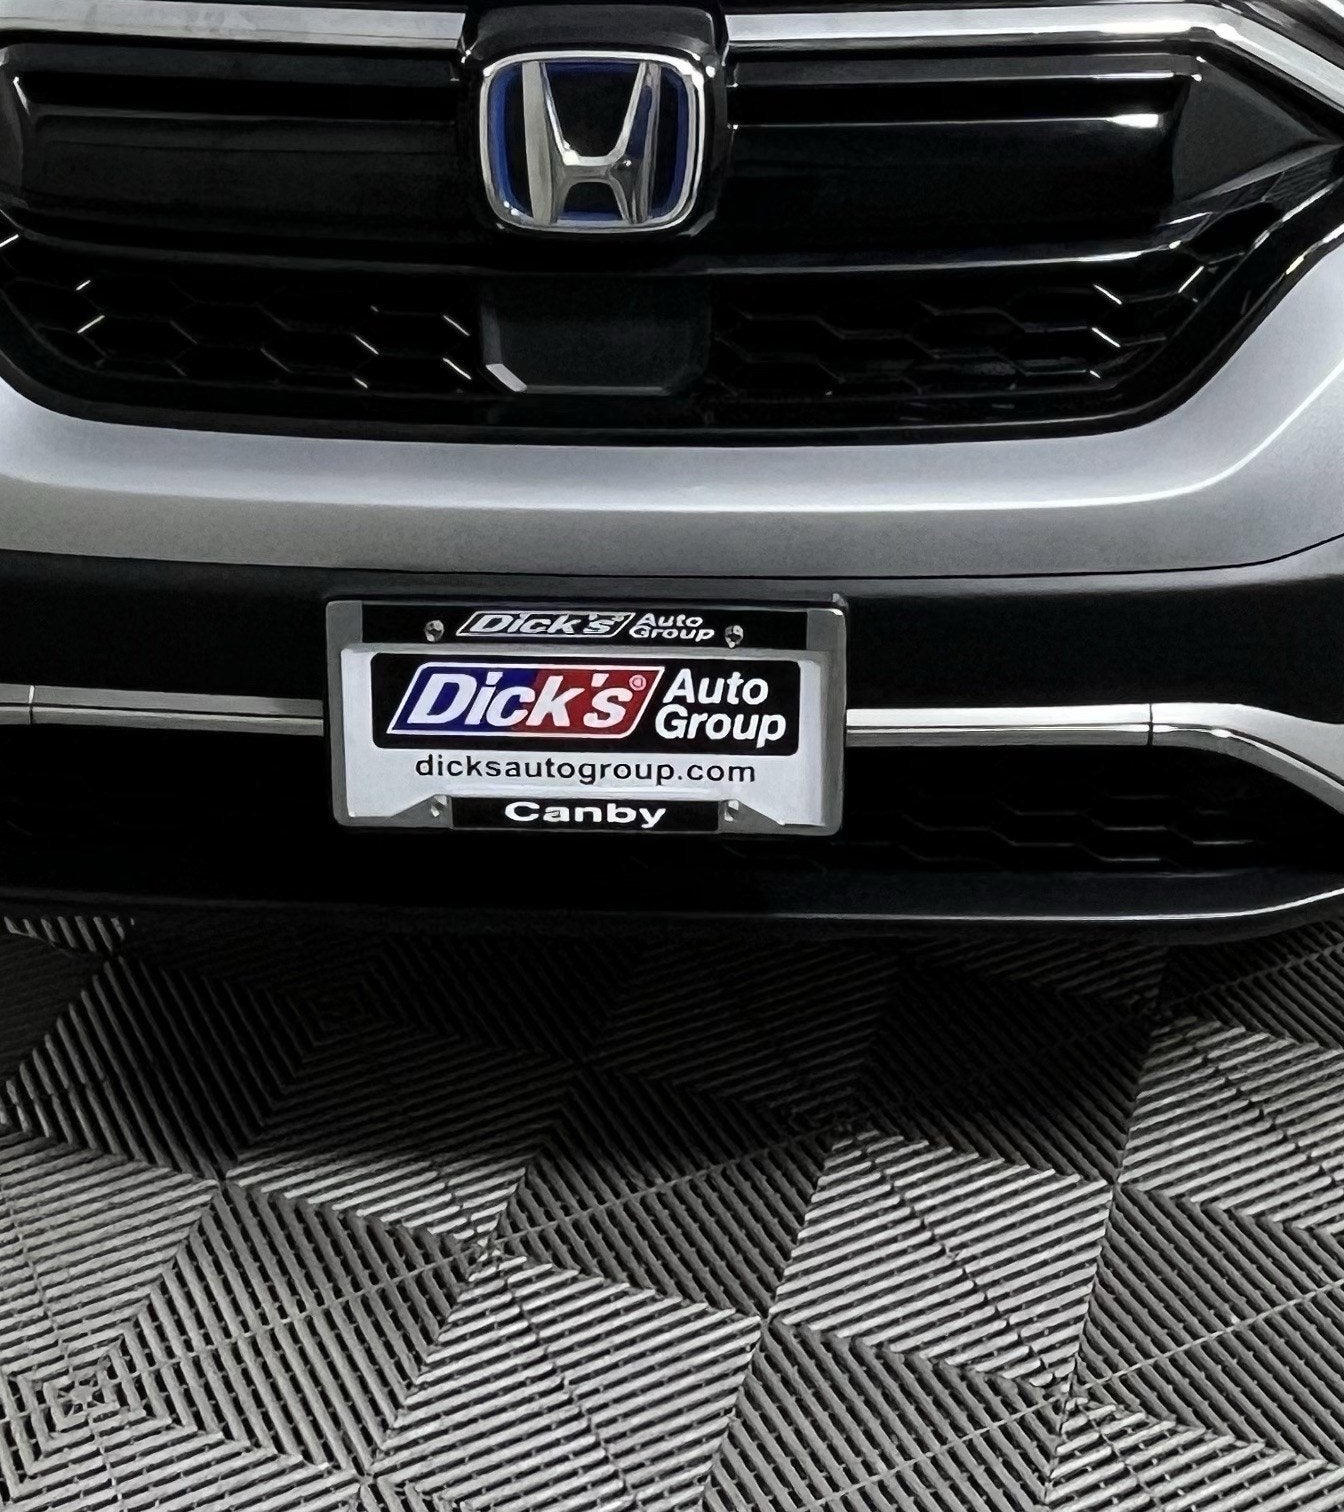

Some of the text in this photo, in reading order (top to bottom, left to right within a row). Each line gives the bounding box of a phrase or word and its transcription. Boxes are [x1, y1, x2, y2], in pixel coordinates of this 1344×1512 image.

[469, 613, 614, 634] Dick's
[628, 625, 715, 642] Group
[636, 613, 703, 628] Auto
[406, 671, 634, 729] Dick's
[662, 668, 769, 706] Auto
[655, 704, 787, 748] Group
[414, 753, 756, 786] dicksautogroup.com
[504, 800, 667, 829] Canby
